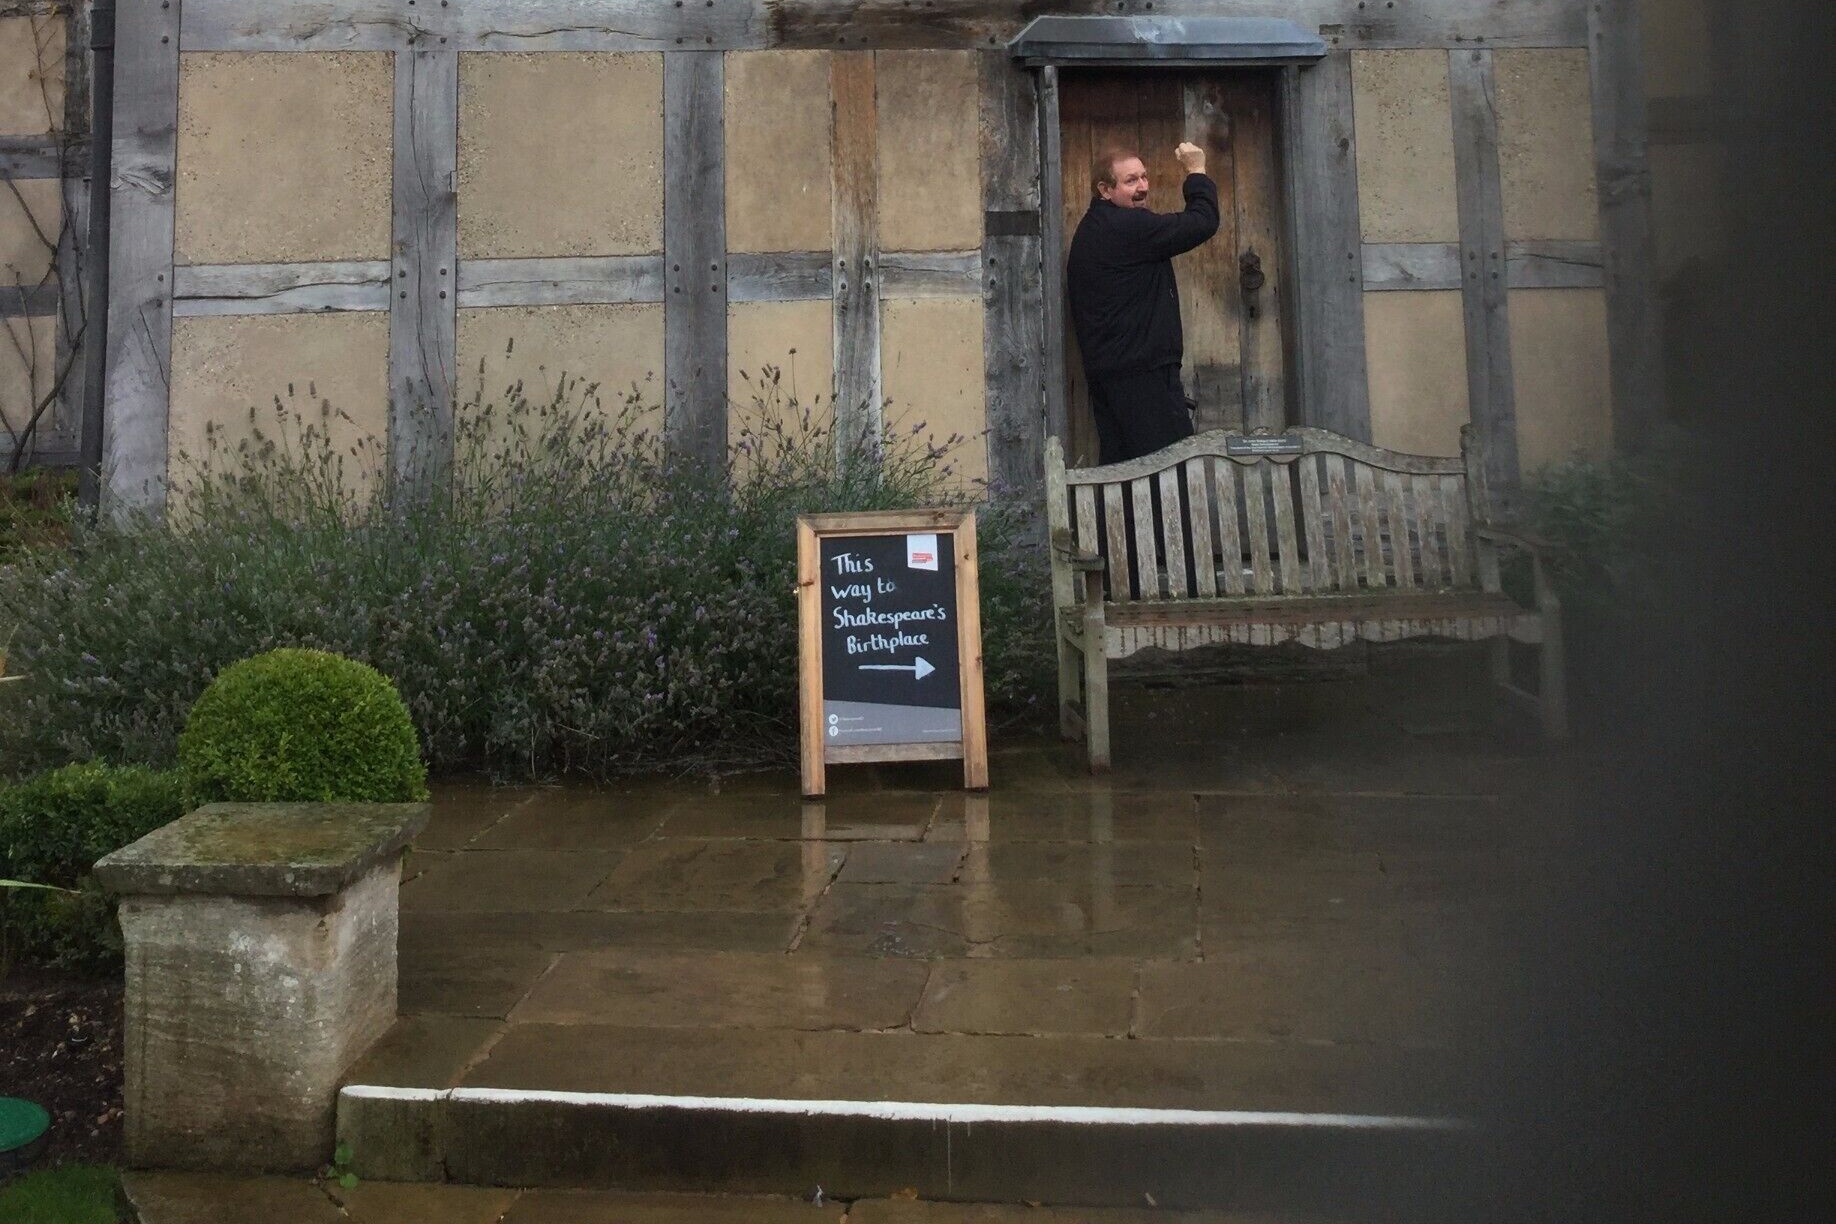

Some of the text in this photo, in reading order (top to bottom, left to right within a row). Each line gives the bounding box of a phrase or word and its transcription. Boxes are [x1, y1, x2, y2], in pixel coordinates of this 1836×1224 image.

[831, 553, 874, 575] This
[831, 577, 896, 603] way to
[833, 603, 947, 630] Shakespeare's
[846, 631, 929, 654] Birthplace
